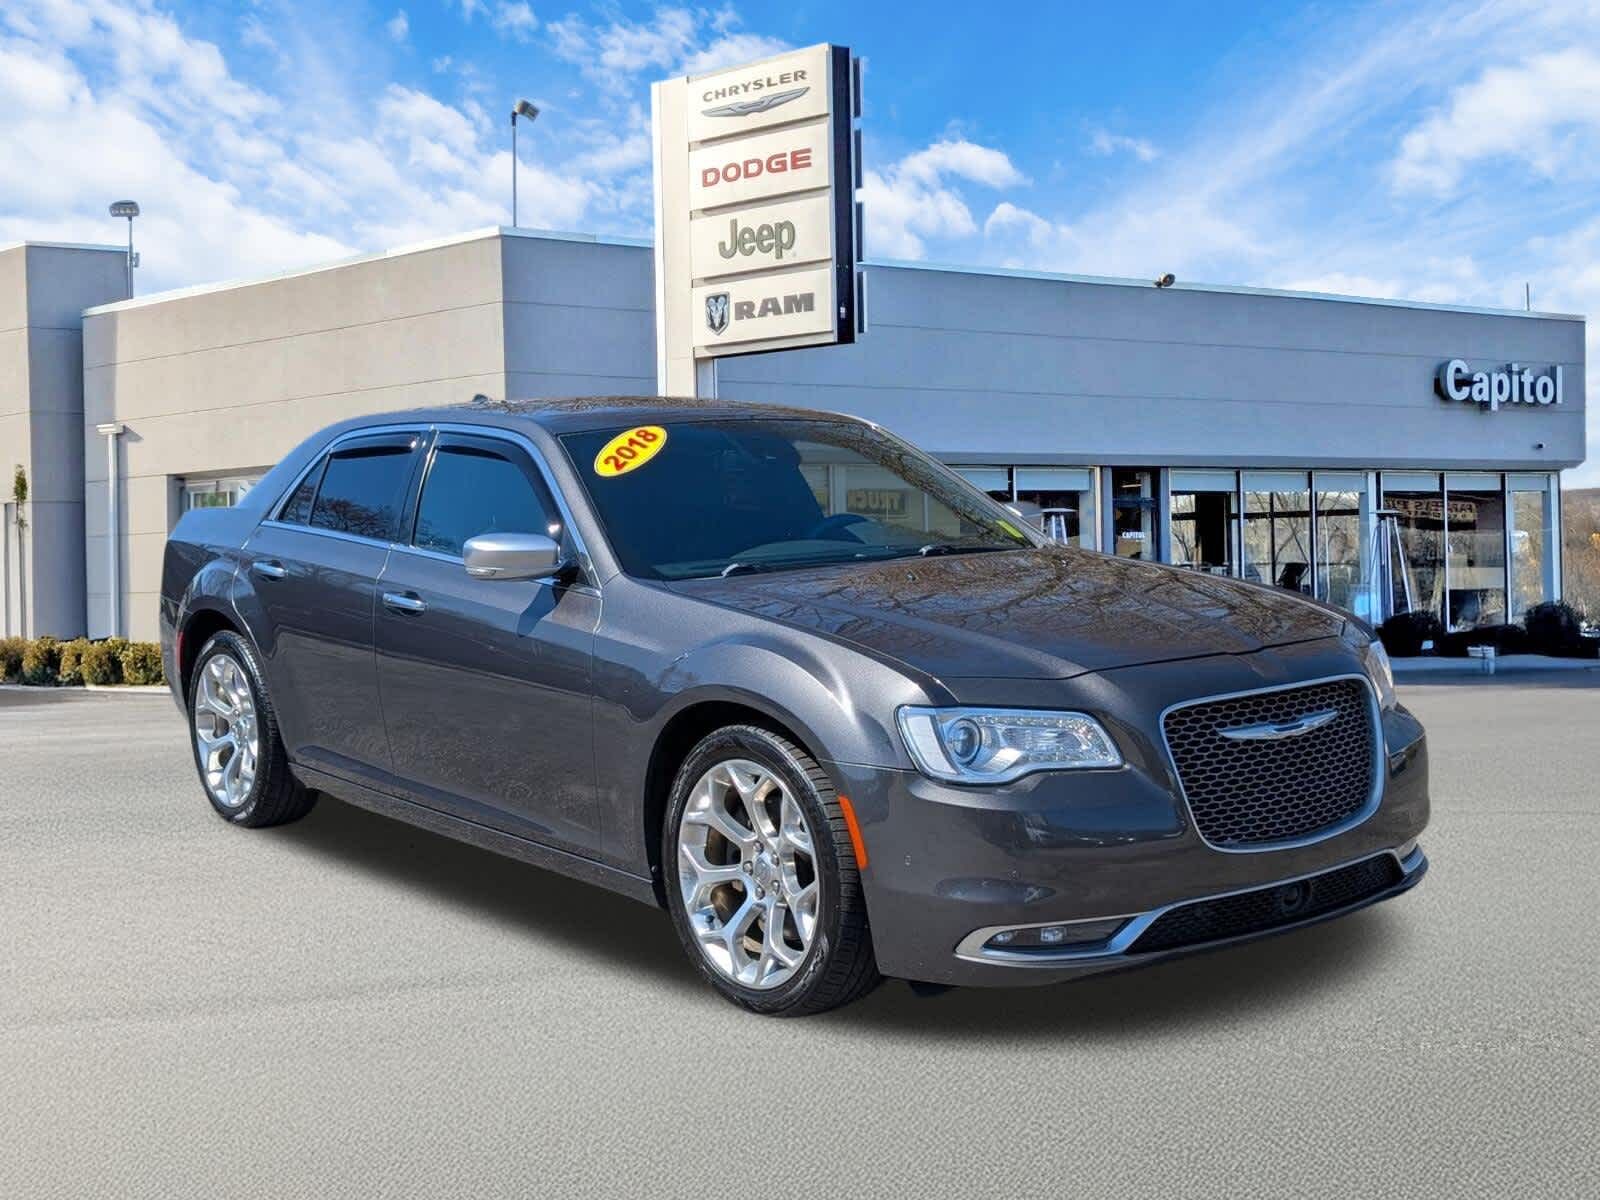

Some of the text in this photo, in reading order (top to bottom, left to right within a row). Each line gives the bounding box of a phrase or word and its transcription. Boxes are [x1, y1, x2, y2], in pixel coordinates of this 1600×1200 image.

[702, 69, 808, 103] CHRYSLER
[702, 147, 813, 188] DODGE
[718, 218, 796, 260] Jeep
[734, 292, 815, 321] RAM
[1445, 359, 1563, 412] Capitol
[603, 429, 658, 471] 2018
